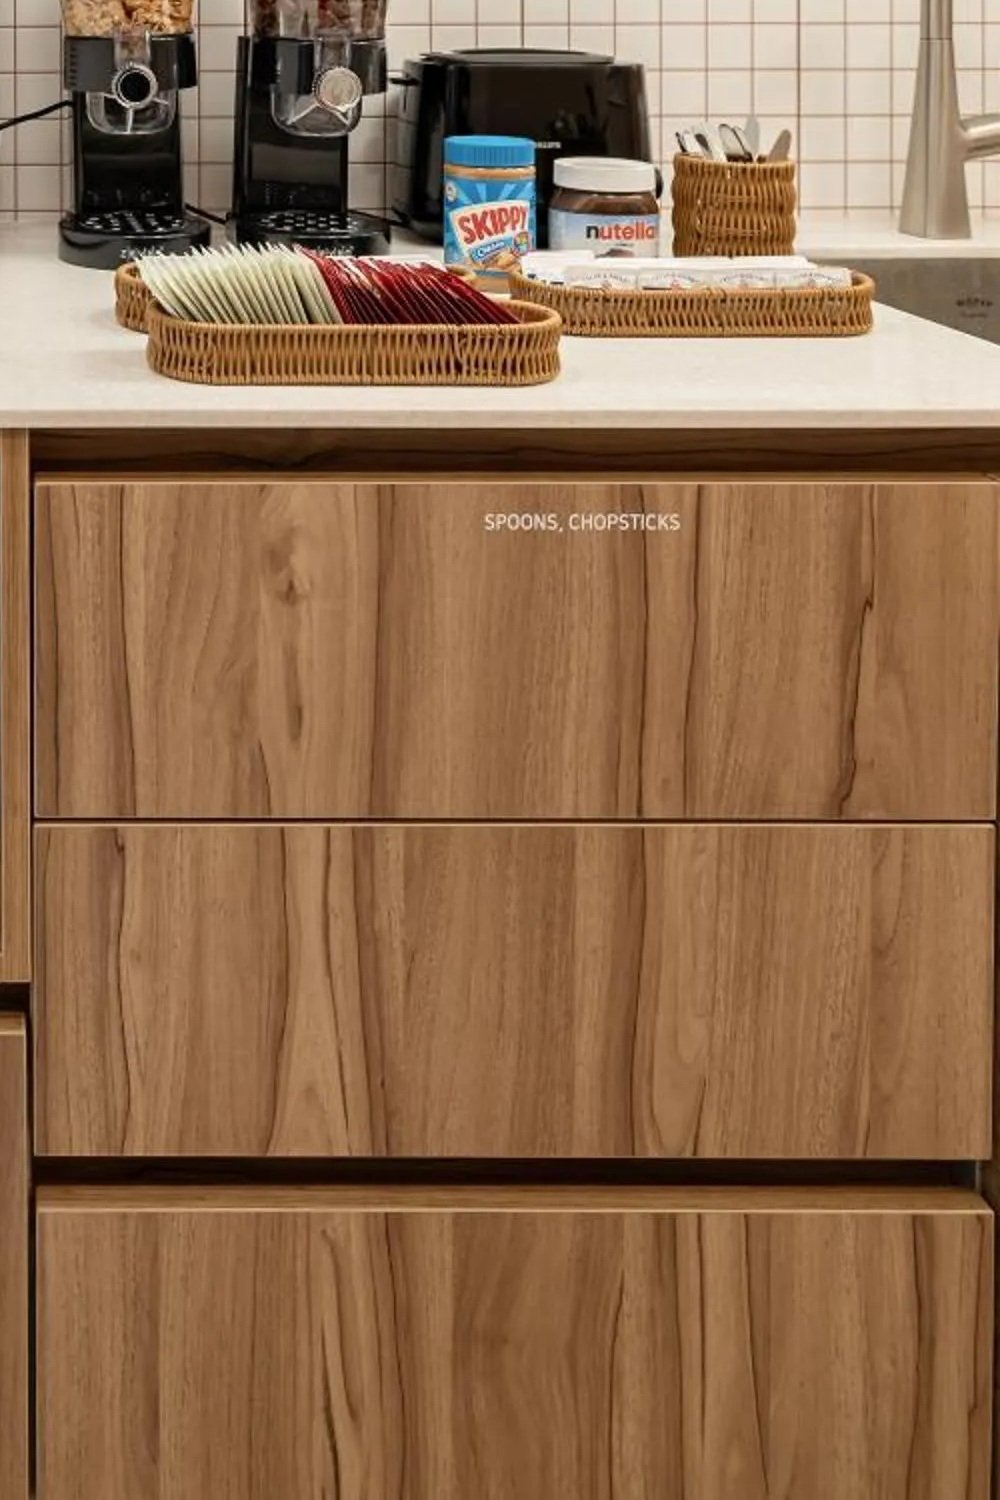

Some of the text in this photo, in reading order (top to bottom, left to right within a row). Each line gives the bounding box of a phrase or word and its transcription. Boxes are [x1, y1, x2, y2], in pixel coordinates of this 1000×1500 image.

[458, 206, 527, 245] SKIPPY
[586, 222, 656, 241] nutella
[484, 513, 681, 533] SPOONS, CHOPSTICKS
